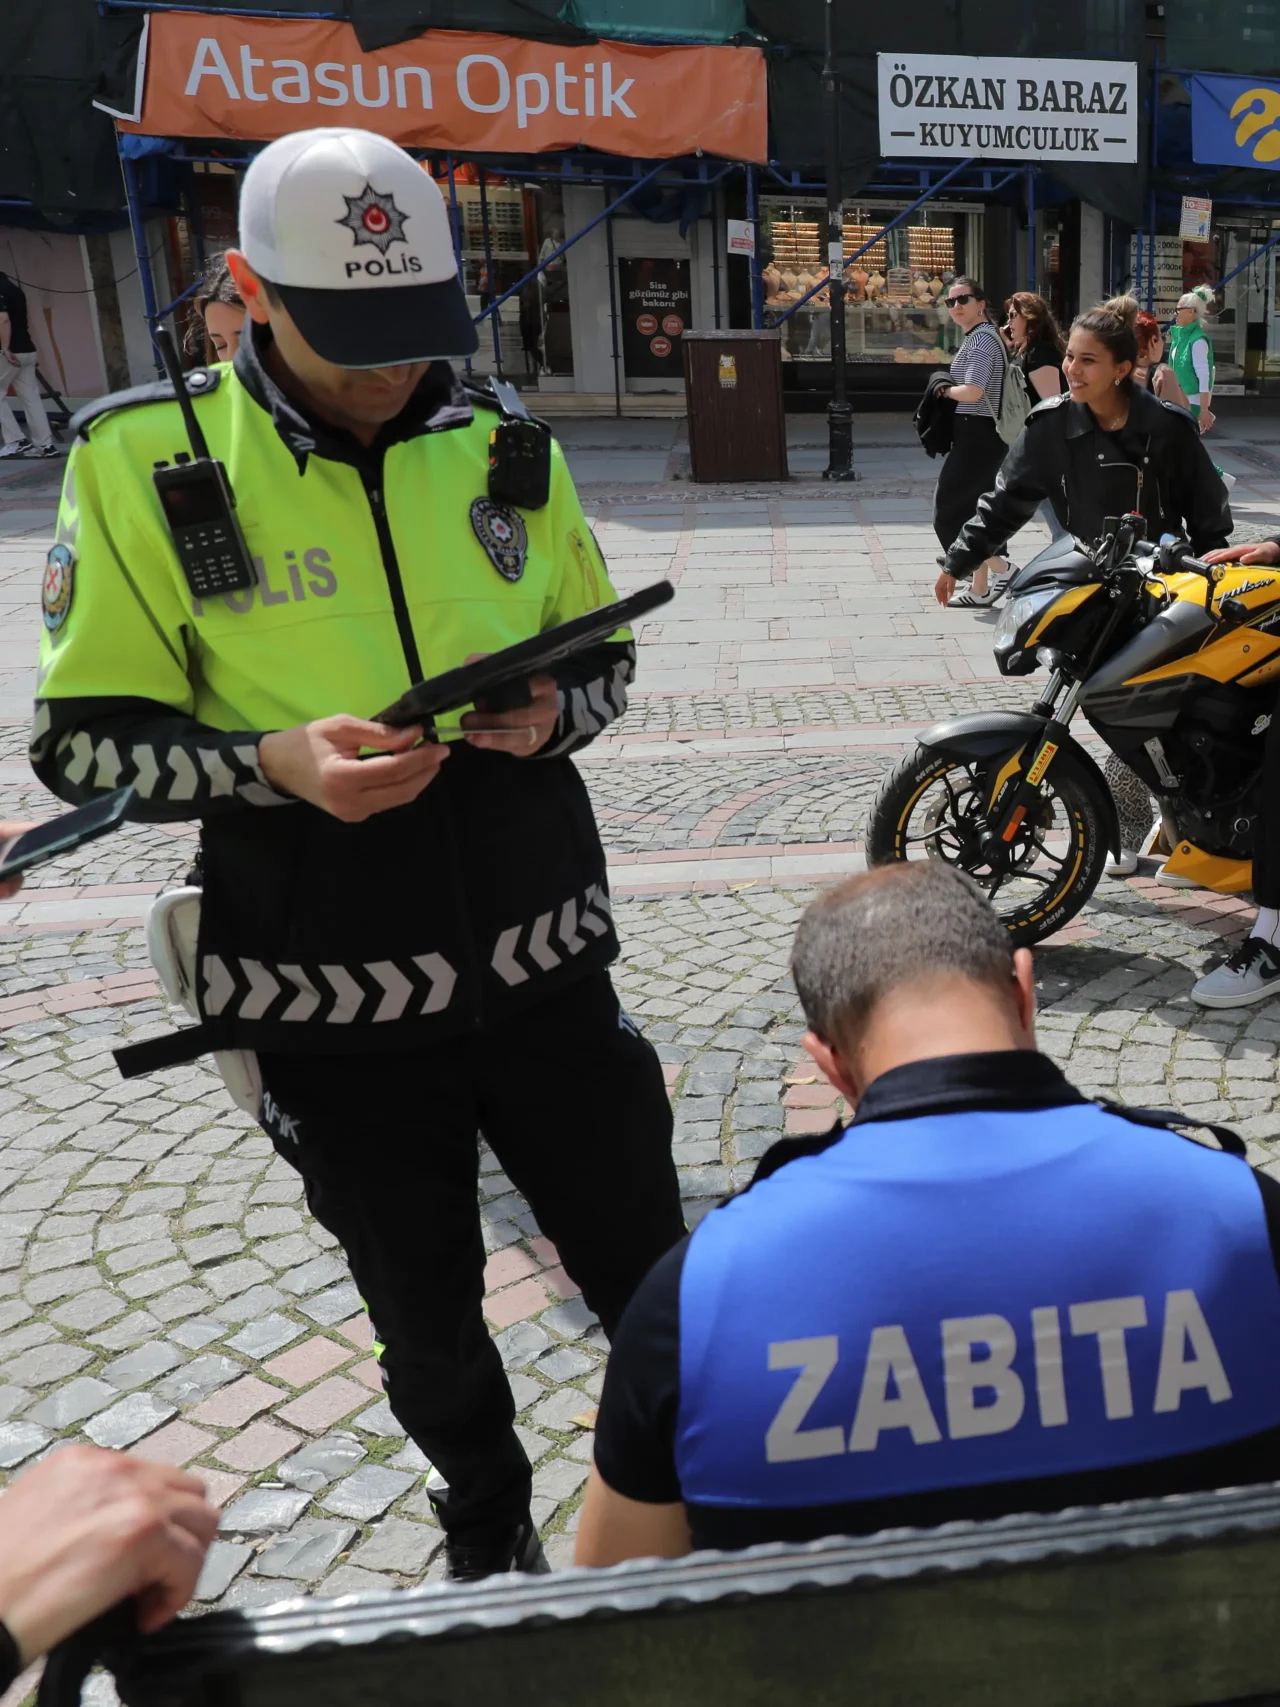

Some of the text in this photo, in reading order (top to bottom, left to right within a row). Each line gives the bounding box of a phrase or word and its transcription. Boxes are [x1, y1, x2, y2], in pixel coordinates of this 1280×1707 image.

[184, 37, 637, 129] Atasun Optik
[889, 63, 1127, 115] ÖZKAN BARAZ
[919, 122, 1100, 151] KUYUMCULUK
[629, 290, 688, 301] gözümüz gibi
[649, 281, 667, 290] Size
[914, 757, 943, 783] MRF
[765, 1288, 1234, 1464] ZABITA
